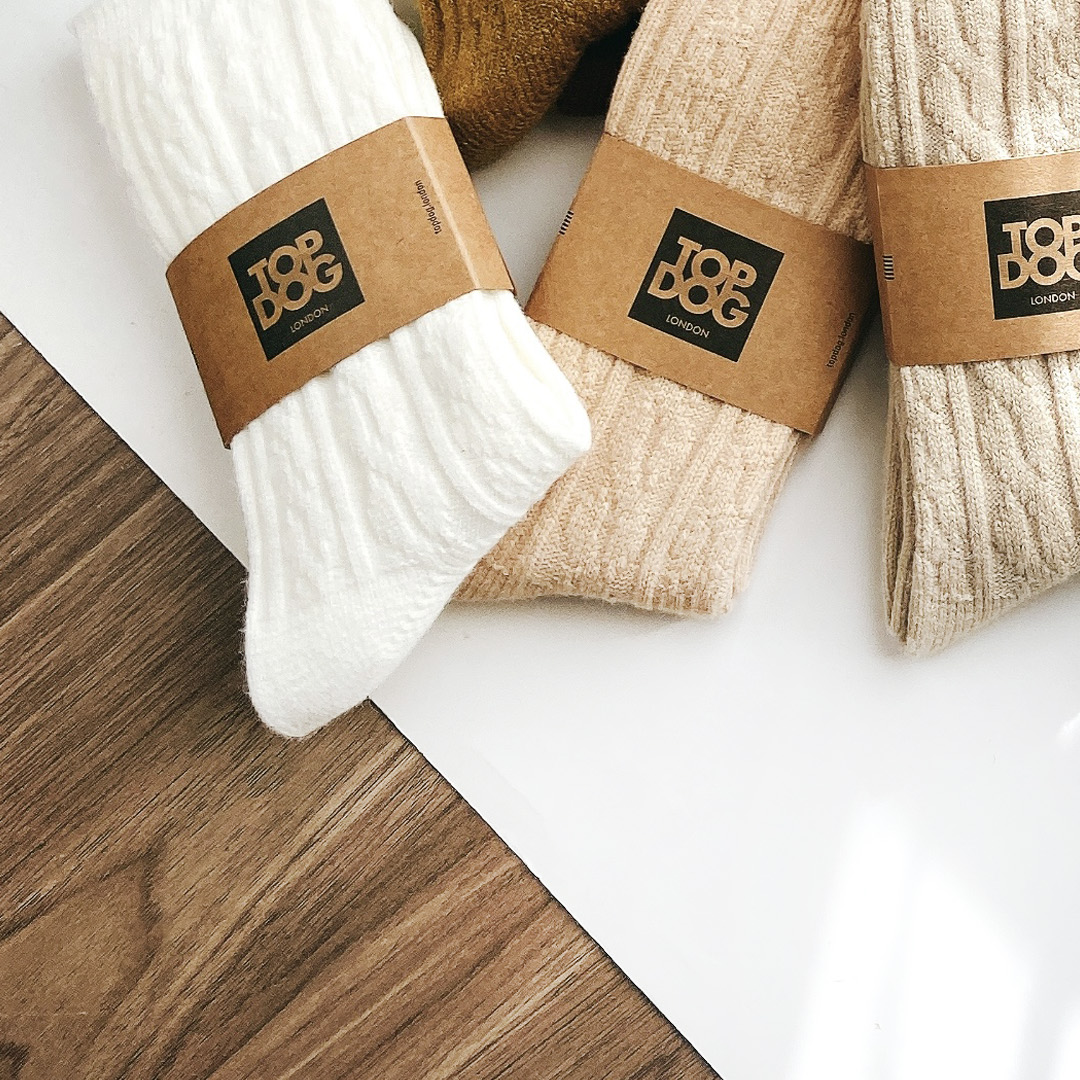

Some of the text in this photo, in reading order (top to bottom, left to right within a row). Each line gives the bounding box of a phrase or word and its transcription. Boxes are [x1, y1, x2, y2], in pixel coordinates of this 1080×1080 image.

[247, 229, 324, 290] TOP
[675, 236, 758, 289] TOP
[252, 253, 344, 332] DOG
[289, 304, 330, 333] LONDON
[647, 260, 751, 329] DOG
[1030, 291, 1077, 306] LONDON
[665, 313, 711, 339] LONDON
